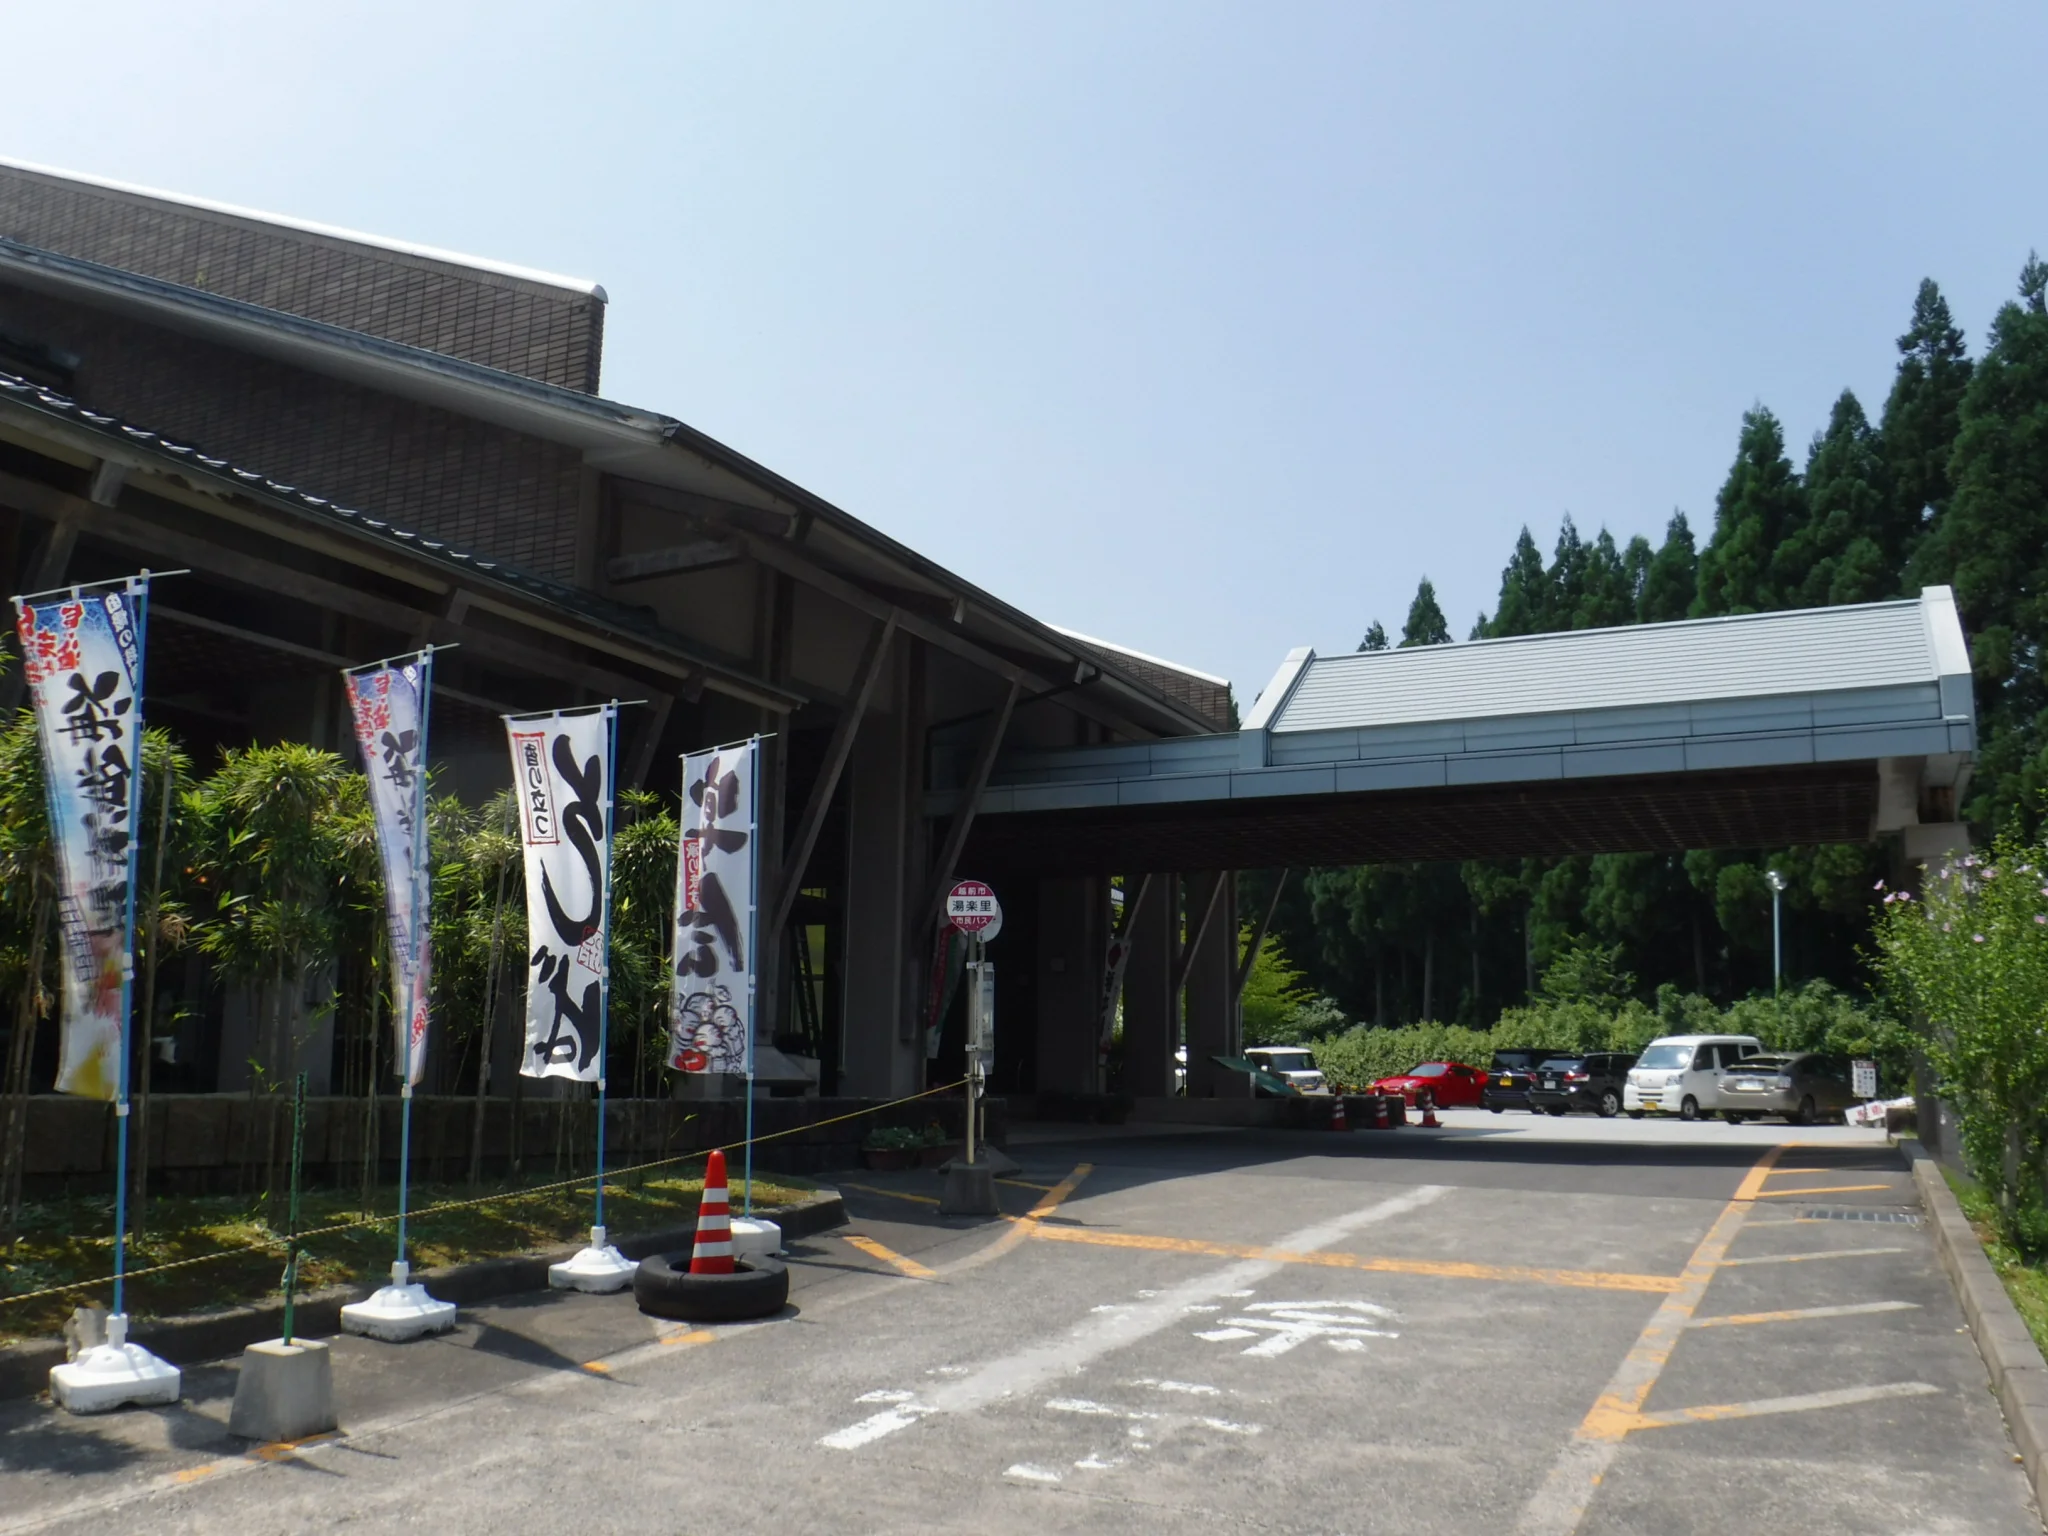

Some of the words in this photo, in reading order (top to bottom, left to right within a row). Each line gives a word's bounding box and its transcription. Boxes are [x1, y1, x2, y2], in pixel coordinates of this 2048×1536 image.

[958, 886, 986, 895] 越前市
[952, 900, 992, 912] 湯楽里
[956, 916, 988, 925] 市民バス
